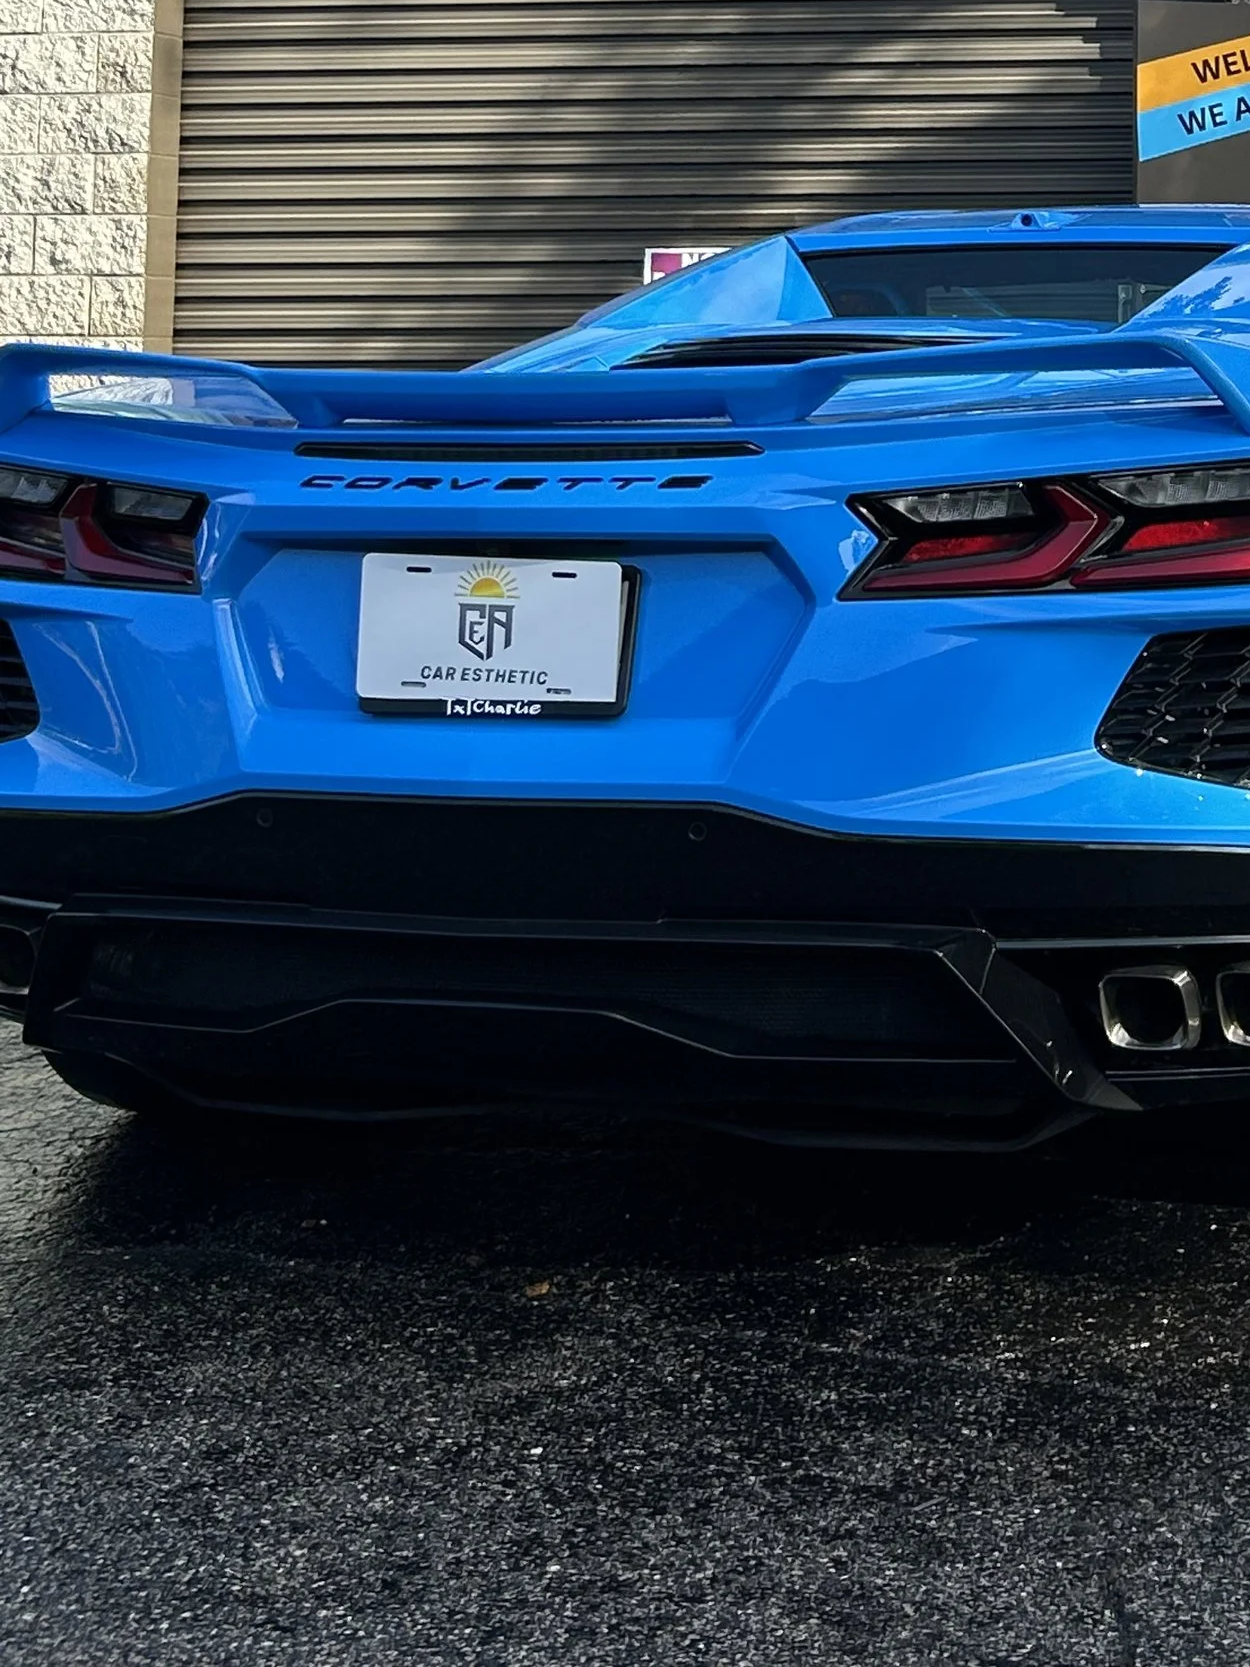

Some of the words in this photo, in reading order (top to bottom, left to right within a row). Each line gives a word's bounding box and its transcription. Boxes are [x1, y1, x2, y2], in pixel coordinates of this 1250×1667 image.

[1177, 102, 1228, 135] WE
[300, 475, 714, 490] CORVETTE
[420, 666, 455, 681] CAR
[460, 668, 549, 685] ESTHETIC
